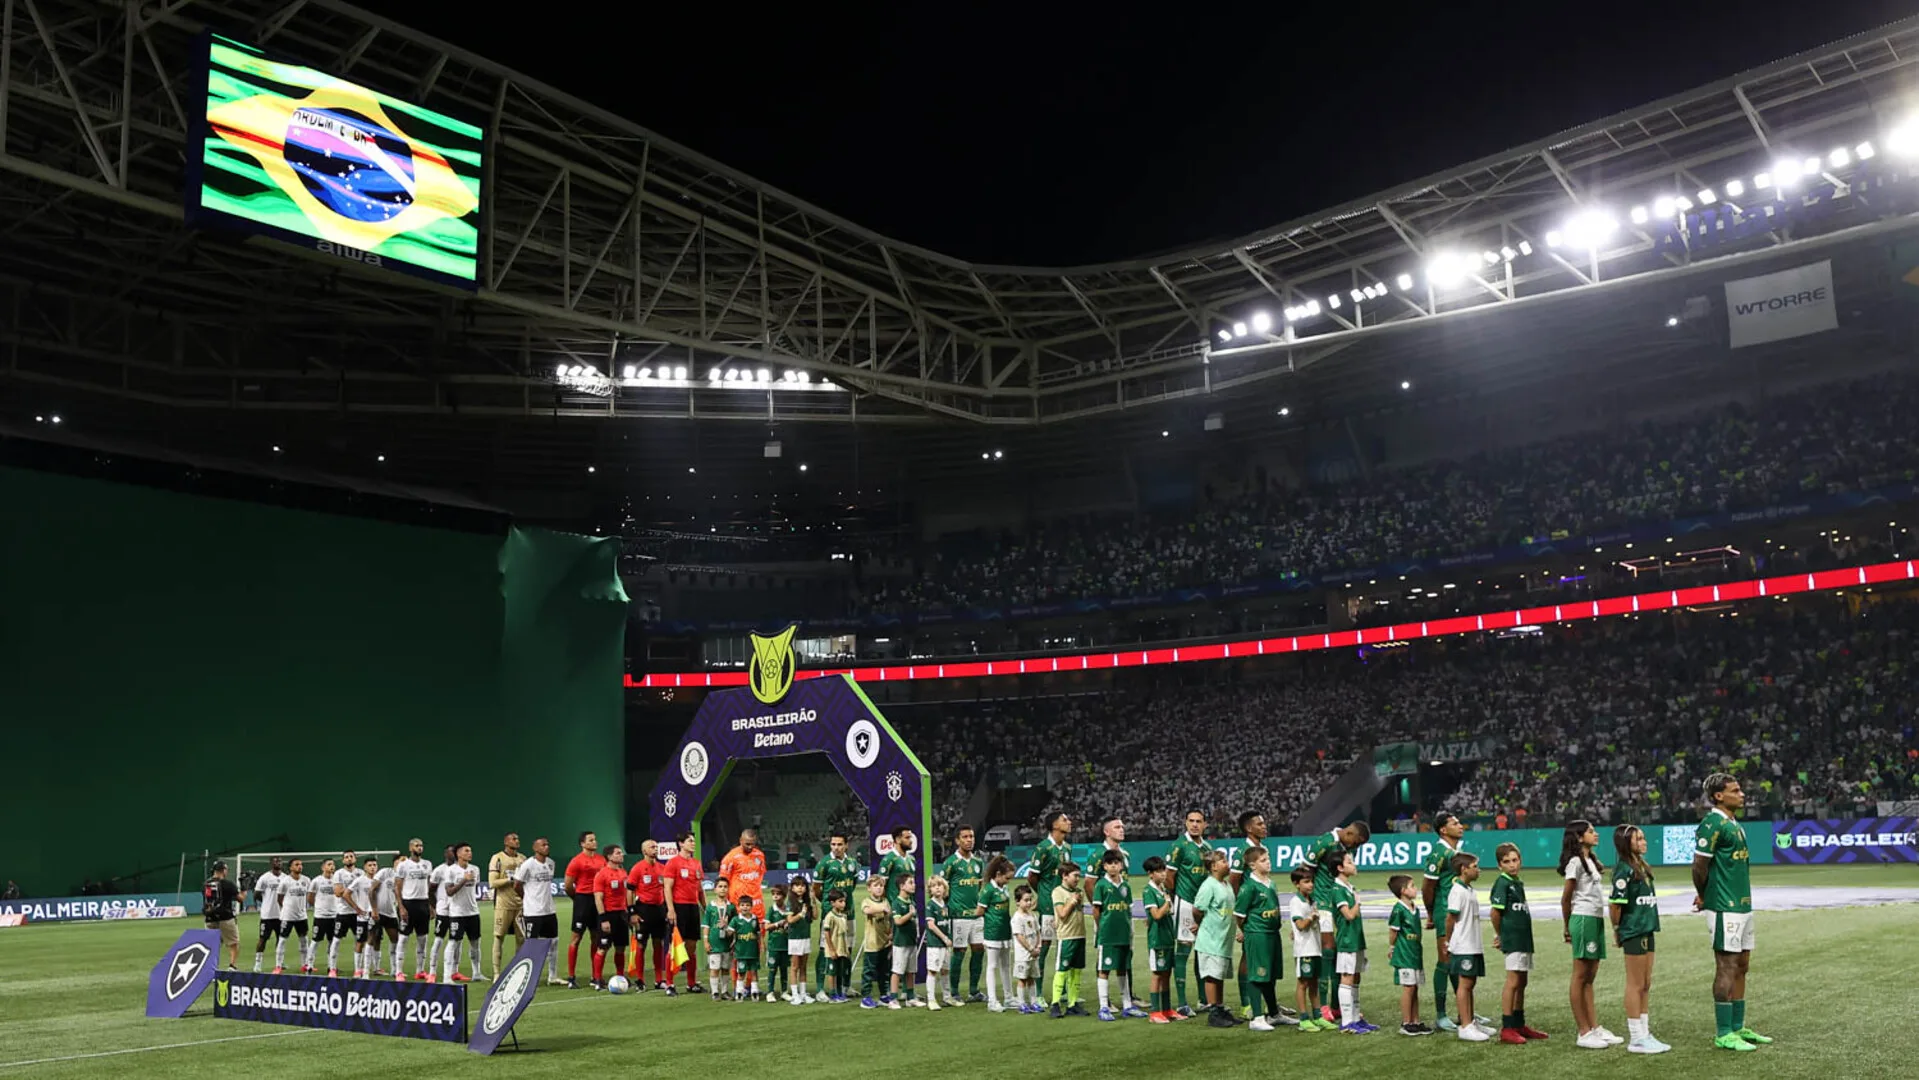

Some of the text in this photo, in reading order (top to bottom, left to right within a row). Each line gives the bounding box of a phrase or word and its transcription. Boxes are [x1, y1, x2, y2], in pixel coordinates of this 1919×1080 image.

[317, 240, 382, 267] aiwa
[1735, 287, 1825, 315] WTORRE
[731, 707, 817, 731] BRASILEIRÃO
[753, 732, 794, 748] Betano
[1418, 741, 1482, 761] MAFIA
[1276, 841, 1410, 867] PAIRAS
[21, 901, 122, 919] PALMEIRAS
[1727, 921, 1741, 933] 27
[230, 986, 455, 1025] BRASILEIRÃO Betano 2024
